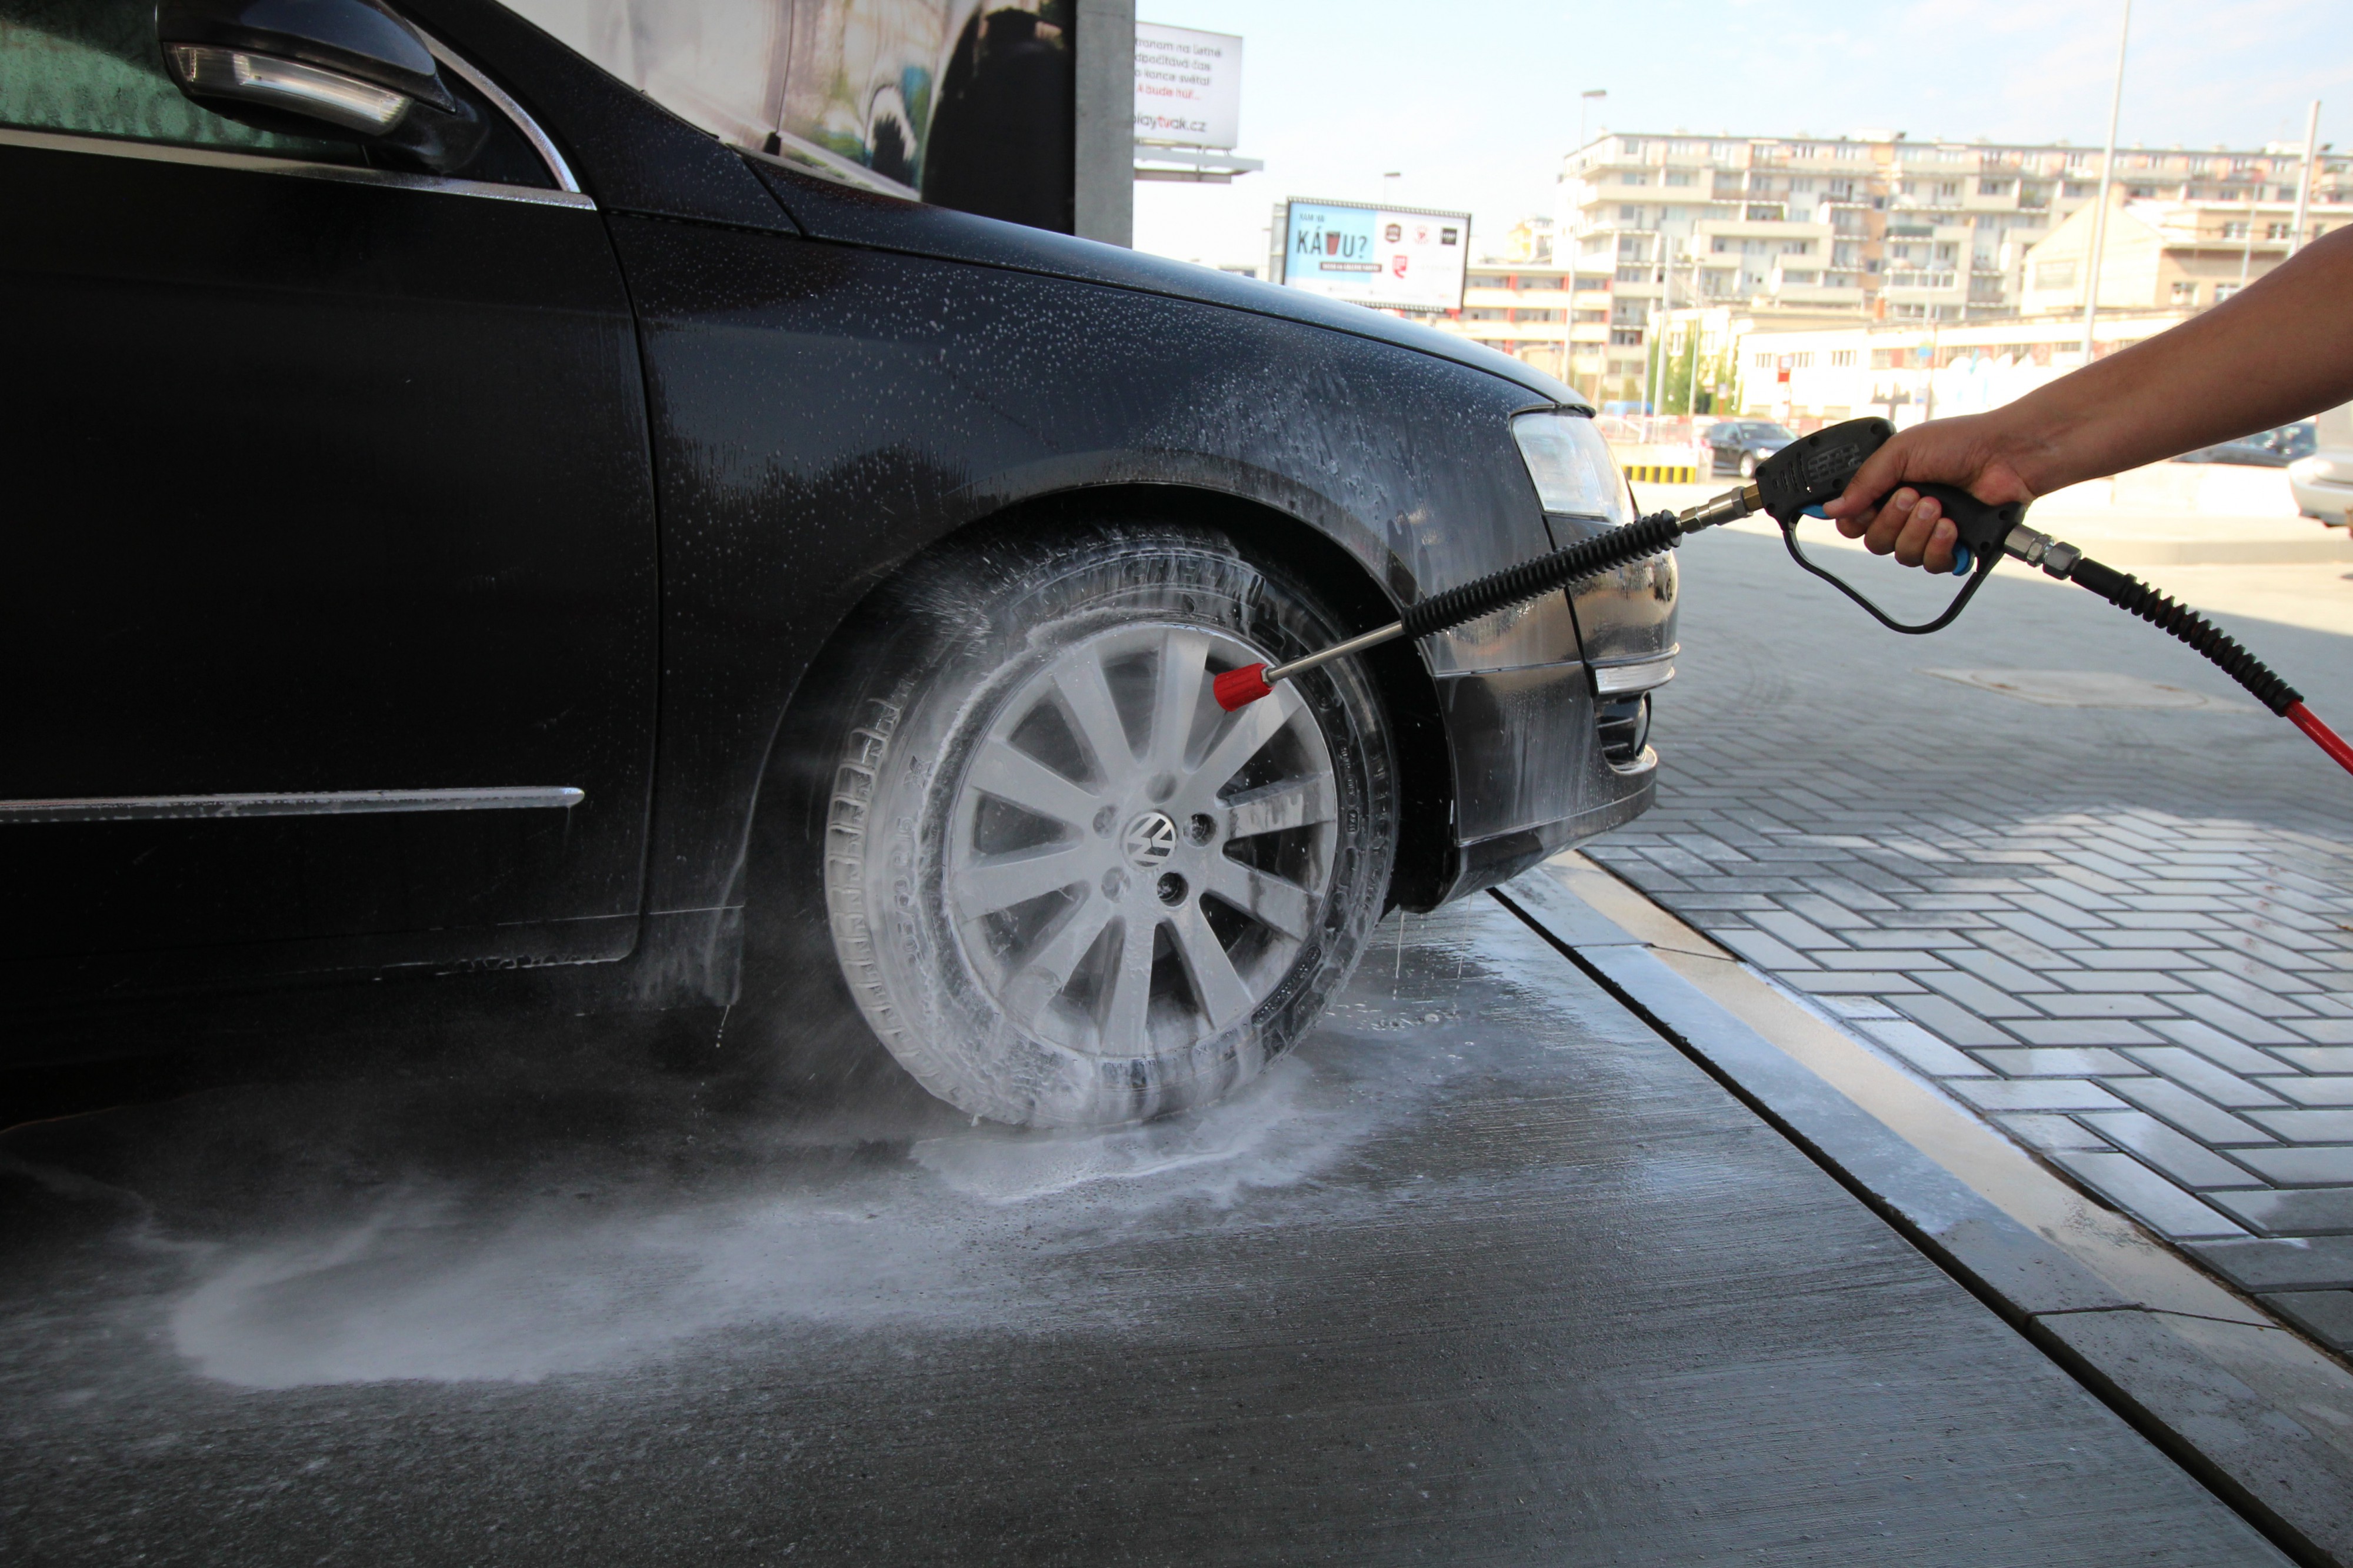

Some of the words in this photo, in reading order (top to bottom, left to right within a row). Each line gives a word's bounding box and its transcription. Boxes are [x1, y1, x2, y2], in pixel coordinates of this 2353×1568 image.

[1176, 44, 1189, 54] na
[1144, 69, 1175, 82] konce
[1145, 84, 1173, 97] bude
